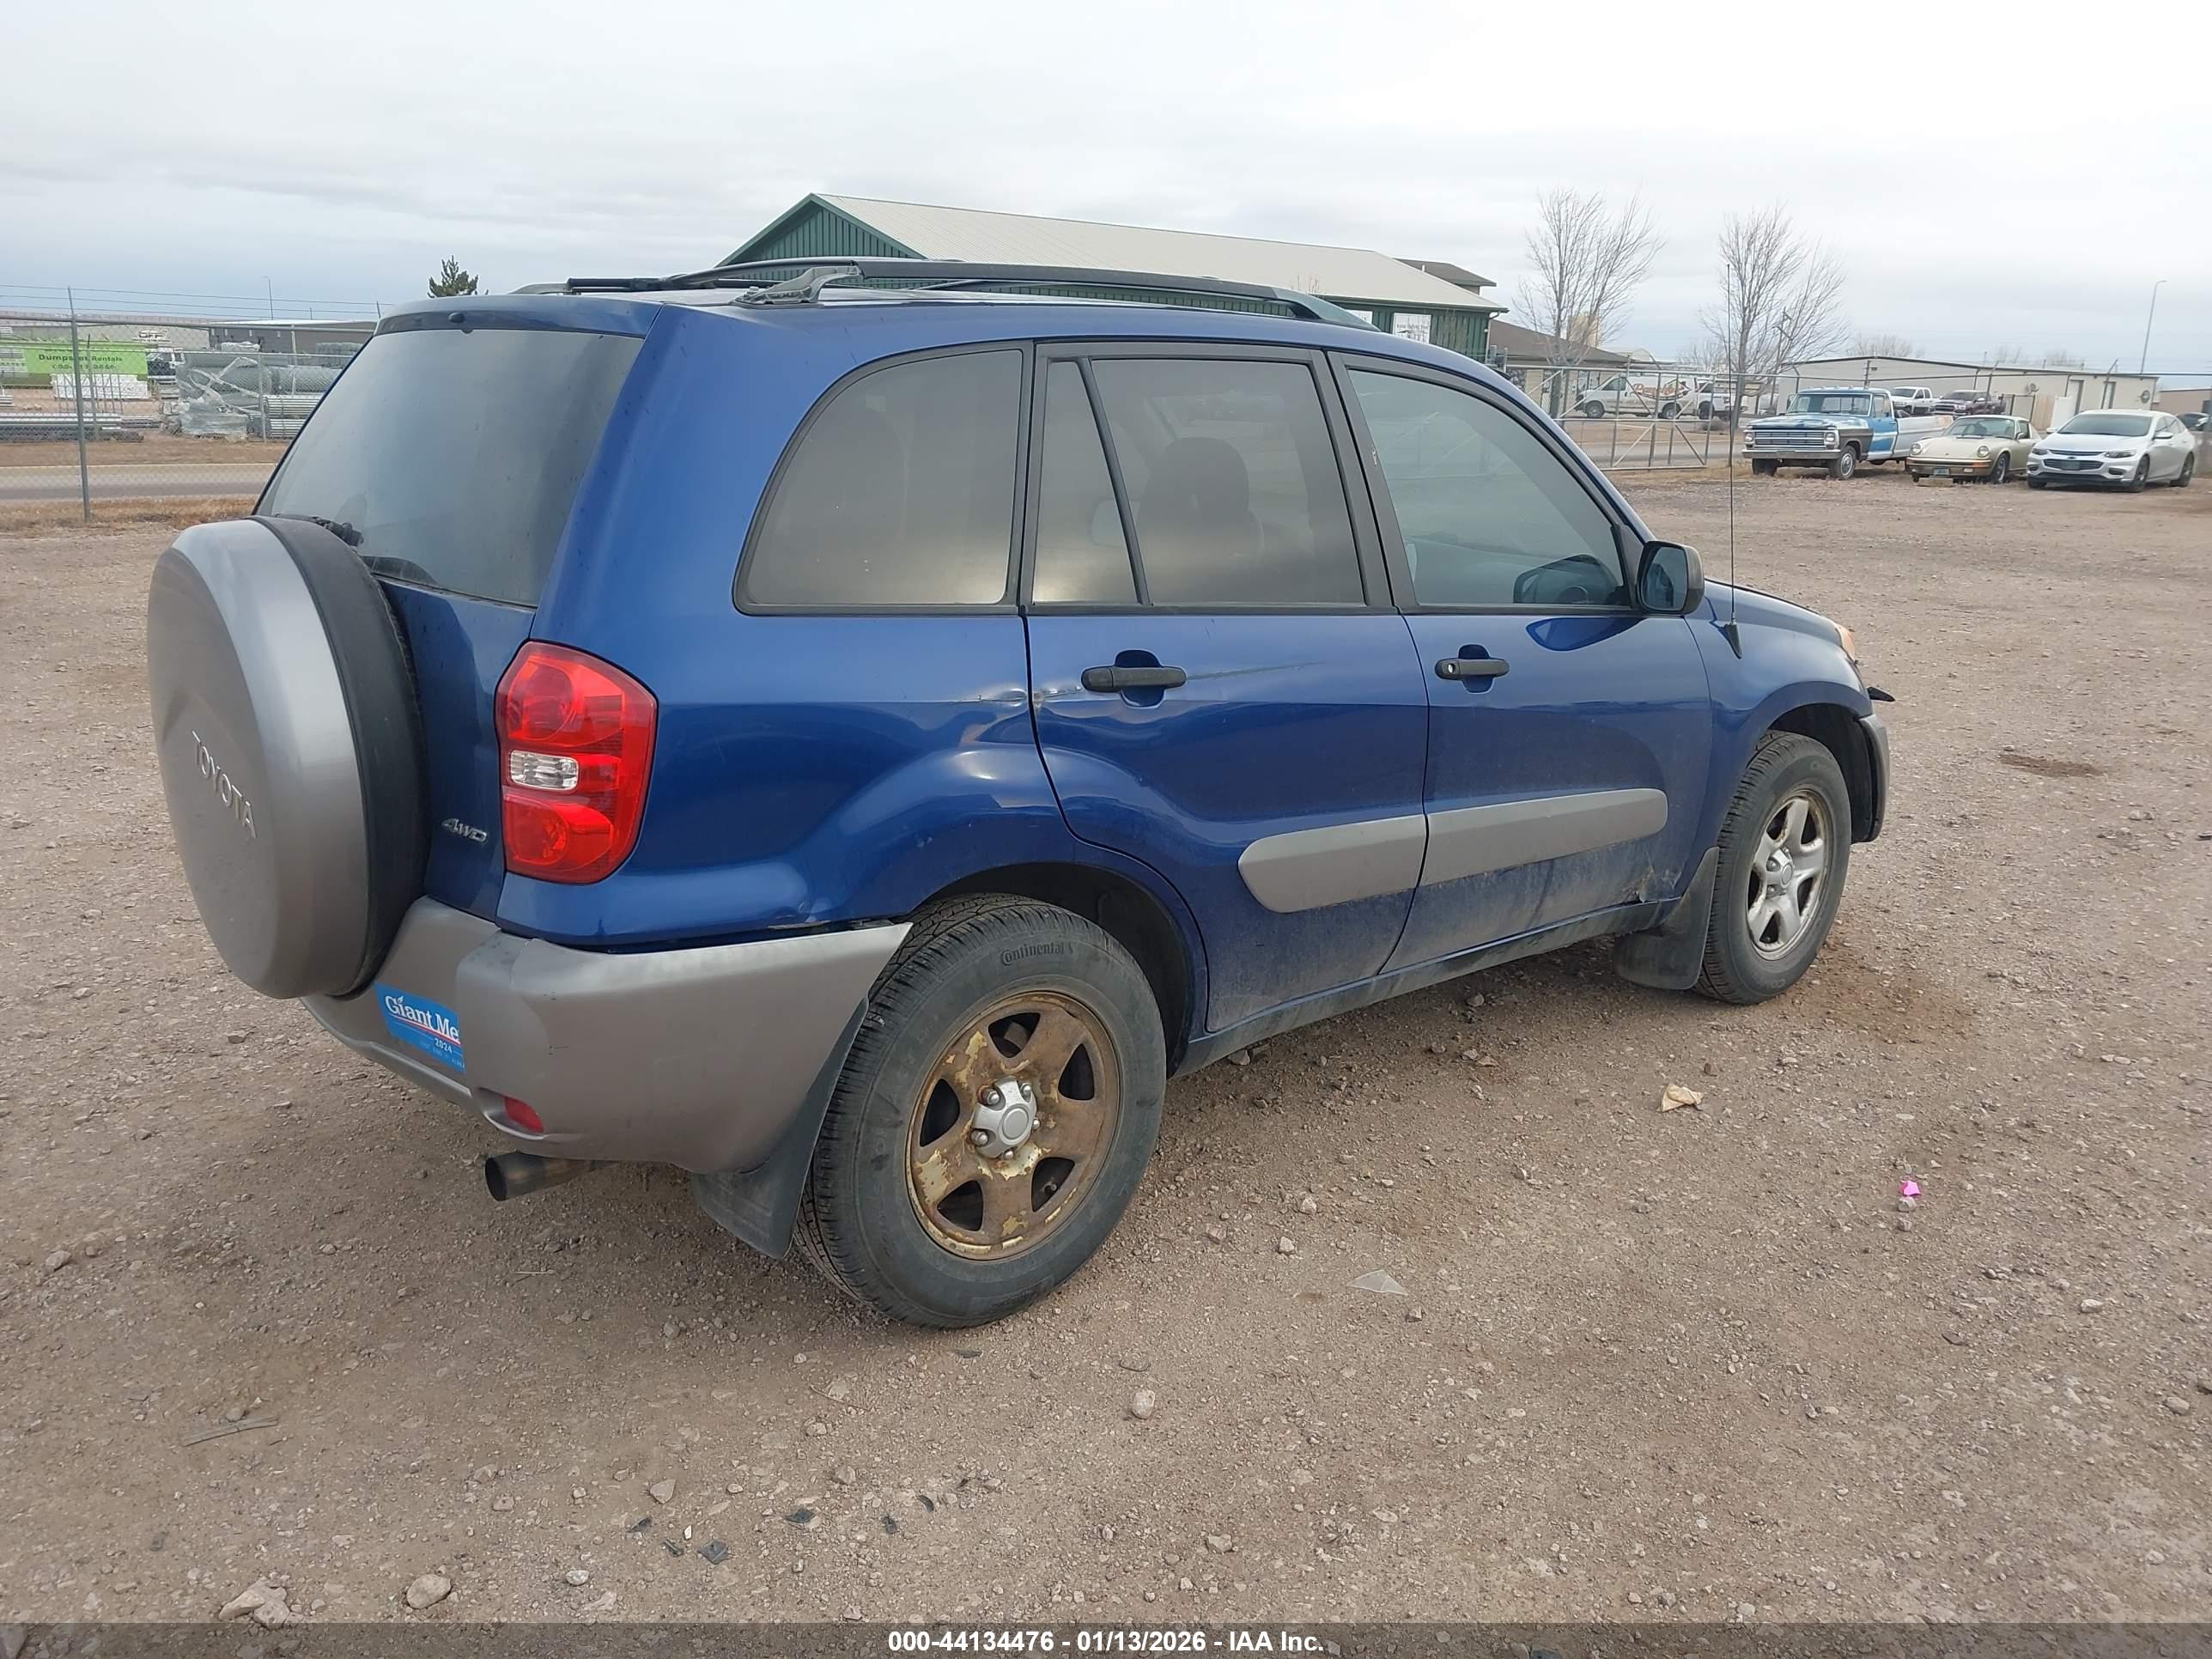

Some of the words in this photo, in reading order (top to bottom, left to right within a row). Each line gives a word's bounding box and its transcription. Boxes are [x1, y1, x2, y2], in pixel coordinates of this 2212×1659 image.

[191, 730, 258, 840] TOYOTA
[441, 817, 488, 842] 4WD
[385, 995, 433, 1030] Giant
[434, 1037, 453, 1054] 2024
